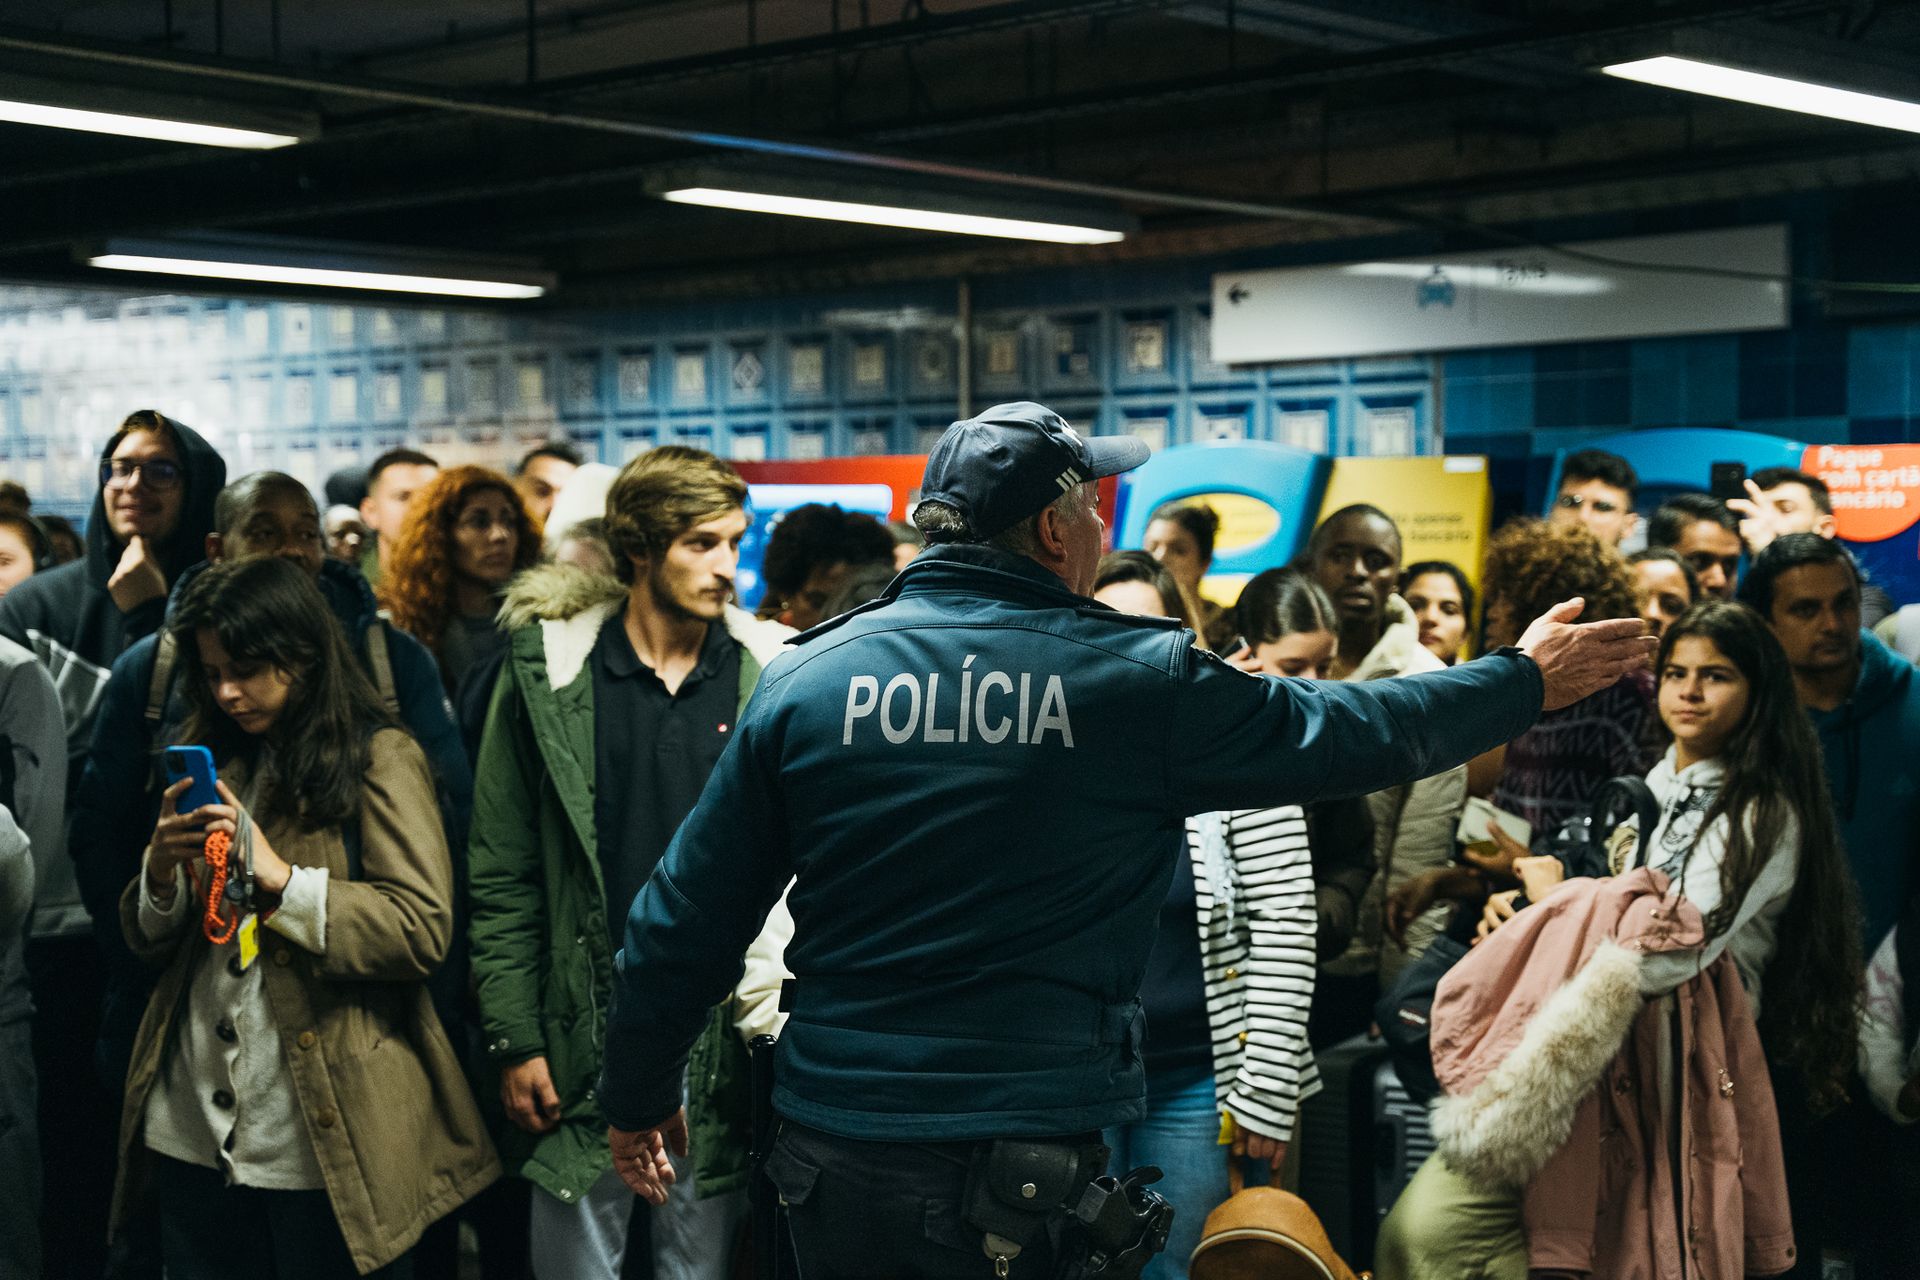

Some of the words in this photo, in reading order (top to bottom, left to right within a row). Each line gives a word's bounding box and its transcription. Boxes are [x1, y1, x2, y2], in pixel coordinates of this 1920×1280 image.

[1818, 446, 1883, 471] Pague
[1865, 465, 1920, 488] cartã
[1830, 488, 1906, 509] ancário
[843, 654, 1075, 748] POLÍCIA
